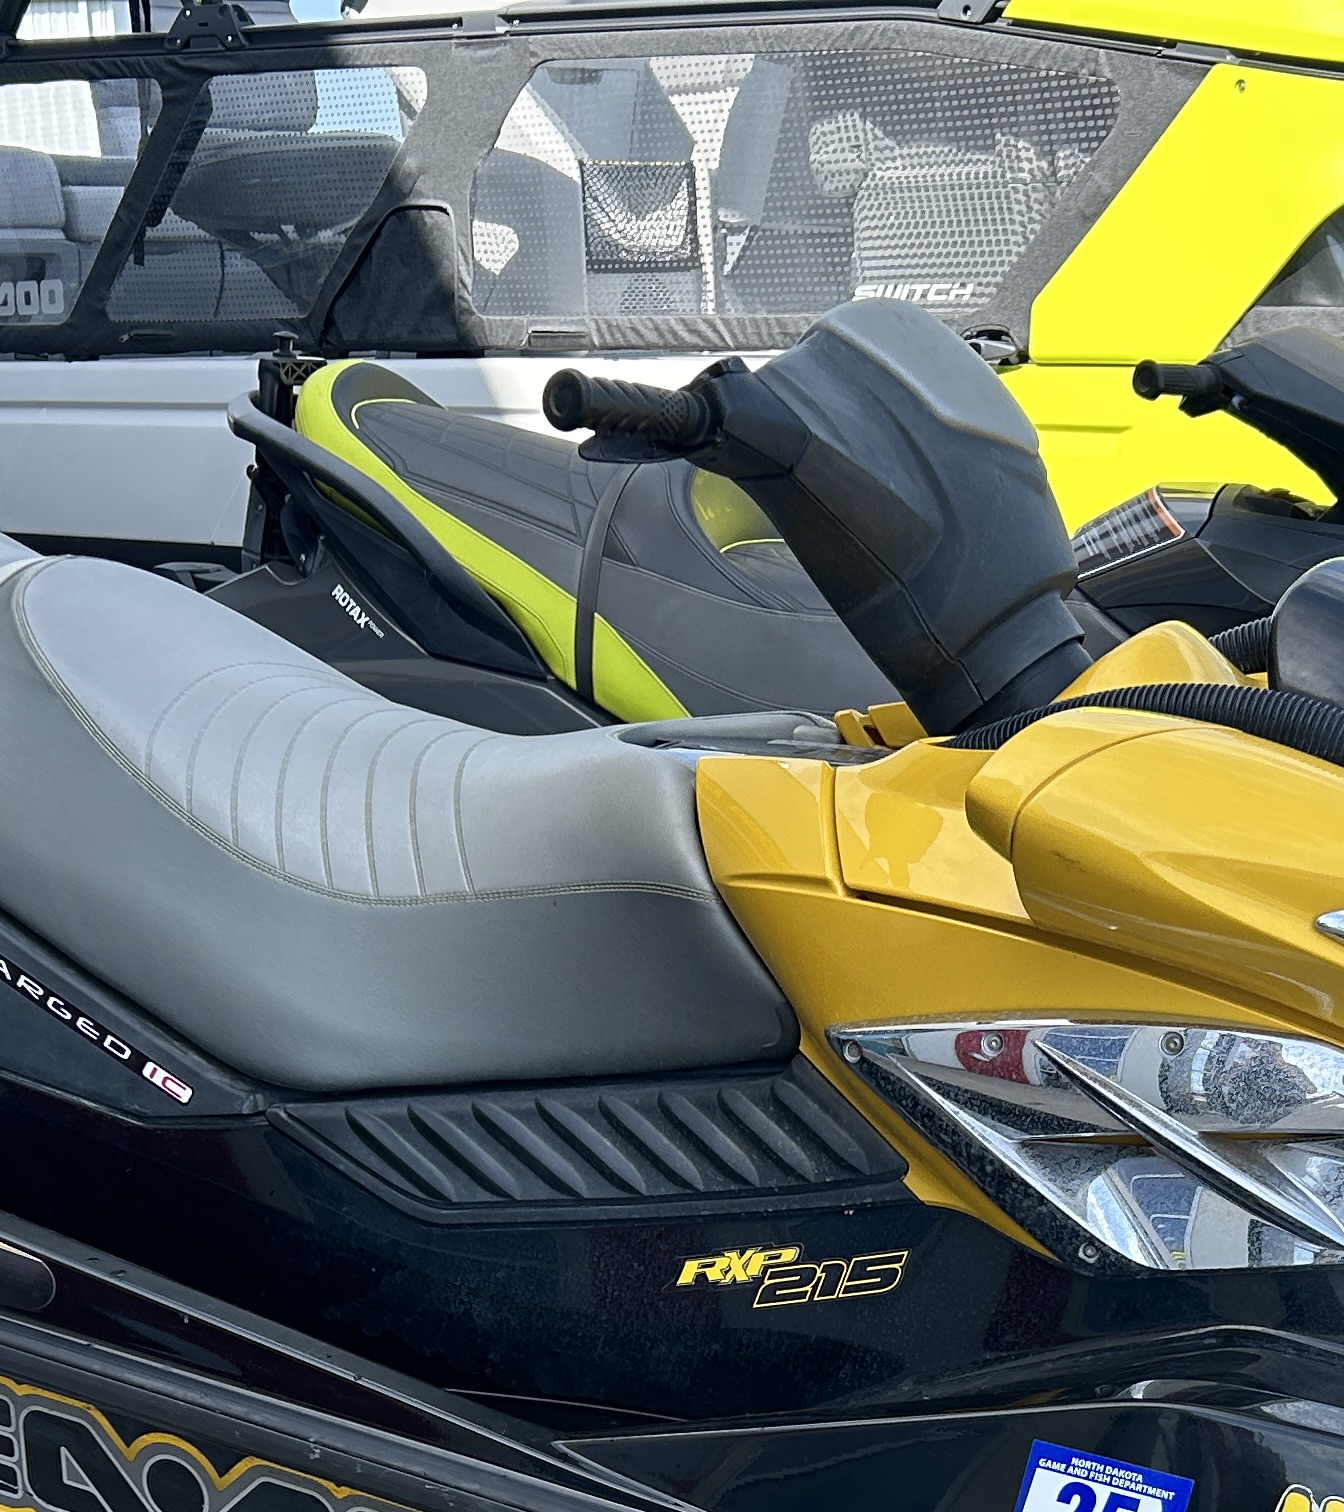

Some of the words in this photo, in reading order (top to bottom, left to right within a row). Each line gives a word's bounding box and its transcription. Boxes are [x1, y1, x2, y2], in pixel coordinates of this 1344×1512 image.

[851, 282, 975, 302] SWITCH
[331, 583, 370, 629] ROTAX
[675, 1247, 799, 1287] RXP
[752, 1250, 909, 1308] 215
[1038, 1458, 1067, 1473] GAME
[1066, 1466, 1089, 1478] AND
[1088, 1471, 1111, 1485] FISH
[1111, 1476, 1176, 1501] DEPARTMENT
[1071, 1456, 1105, 1473] NORTH
[1105, 1465, 1143, 1483] DAKOTA
